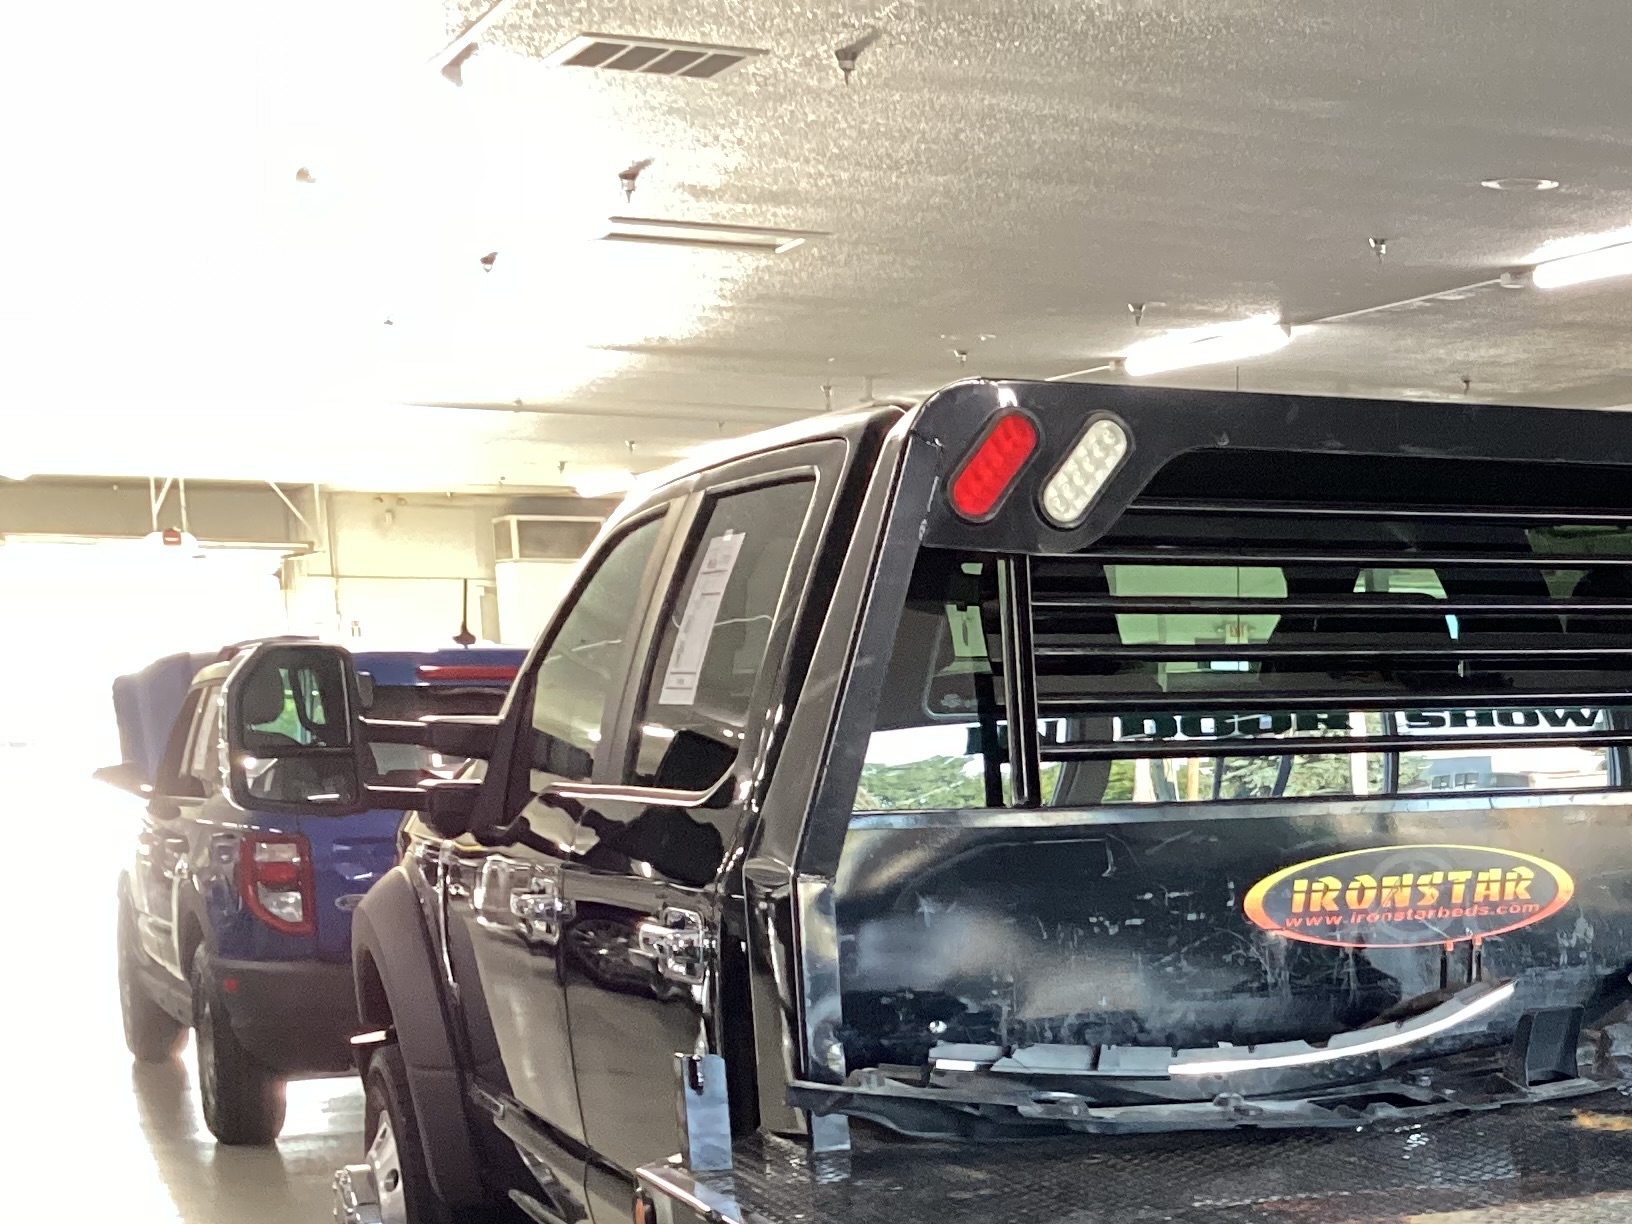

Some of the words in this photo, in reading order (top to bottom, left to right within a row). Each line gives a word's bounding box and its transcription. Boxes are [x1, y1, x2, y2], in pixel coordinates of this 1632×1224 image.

[1402, 707, 1602, 730] SHOW
[1290, 865, 1535, 913] IRONSTAR
[1284, 901, 1541, 928] www.ironstarbeds.com
